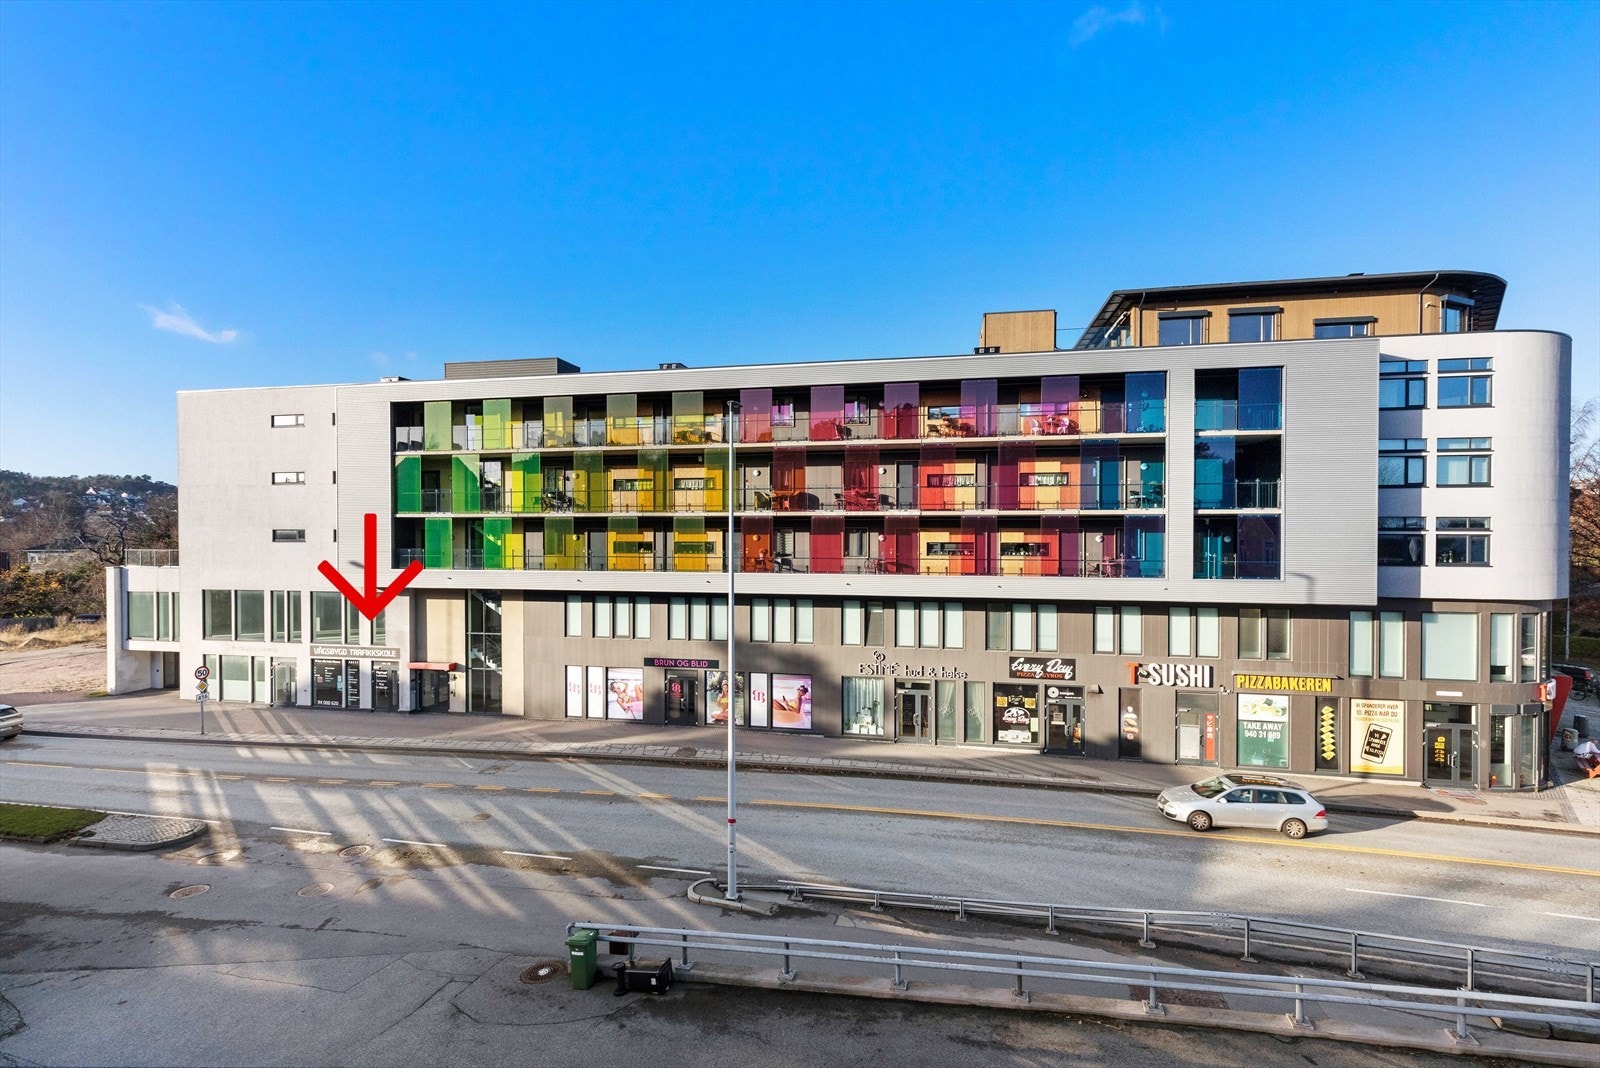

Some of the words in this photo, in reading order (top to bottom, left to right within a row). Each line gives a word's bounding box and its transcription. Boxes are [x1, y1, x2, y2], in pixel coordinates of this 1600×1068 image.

[313, 647, 347, 656] VÅGSBYGD
[349, 649, 396, 657] TRAFIKKSKOLE
[654, 659, 674, 667] BRUN
[691, 660, 708, 668] BLID
[1011, 657, 1043, 679] Every
[1046, 659, 1073, 680] Day
[197, 669, 208, 678] 50
[905, 665, 925, 677] hud
[928, 667, 937, 678] &
[941, 666, 968, 679] helse
[1236, 674, 1332, 692] PIZZABAKEREN
[1243, 722, 1261, 730] TAKE
[1263, 723, 1283, 731] AWAY
